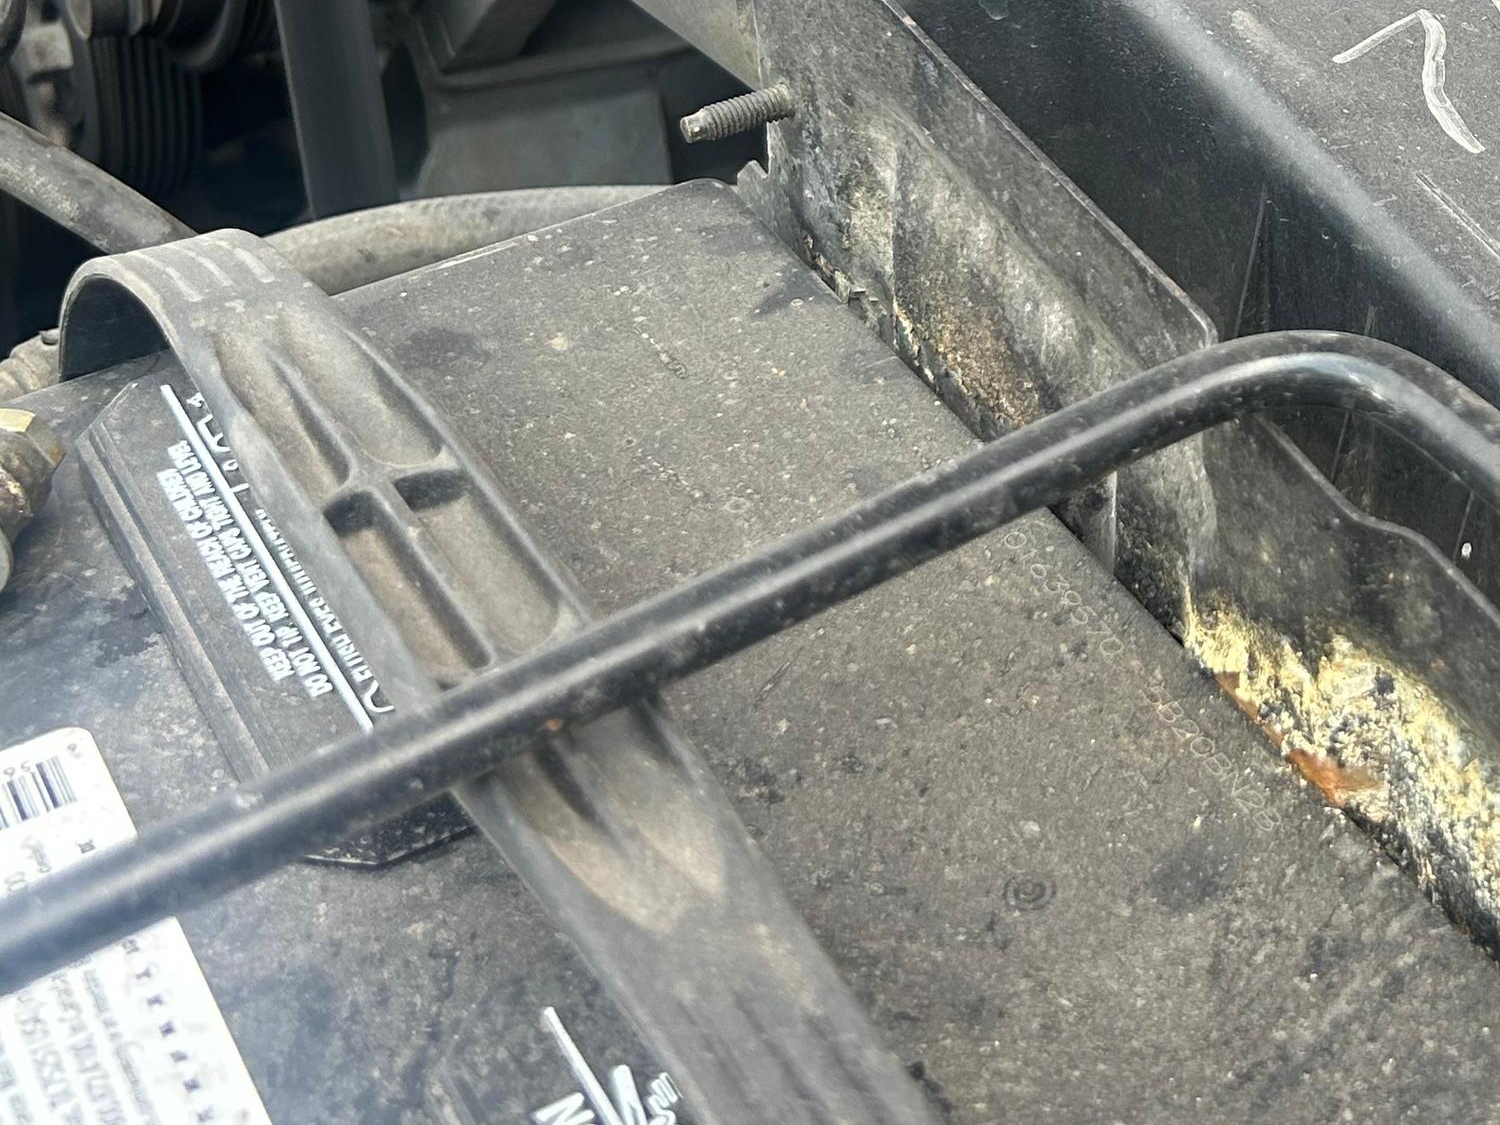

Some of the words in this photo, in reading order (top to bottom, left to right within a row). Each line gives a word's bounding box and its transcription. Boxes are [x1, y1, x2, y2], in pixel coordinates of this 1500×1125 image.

[166, 438, 202, 475] LEVEL
[155, 467, 203, 522] CHILDREN
[184, 470, 215, 496] AND
[197, 494, 234, 531] TIGHT
[185, 520, 213, 539] OF
[217, 526, 253, 560] CAPS
[195, 535, 235, 578] REACH
[218, 573, 249, 603] THE
[234, 557, 270, 594] VENT
[231, 602, 261, 621] OF
[254, 591, 289, 623] KEEP
[242, 618, 277, 648] OUT
[257, 647, 295, 681] KEEP
[286, 645, 321, 677] NOT
[303, 673, 333, 698] DO
